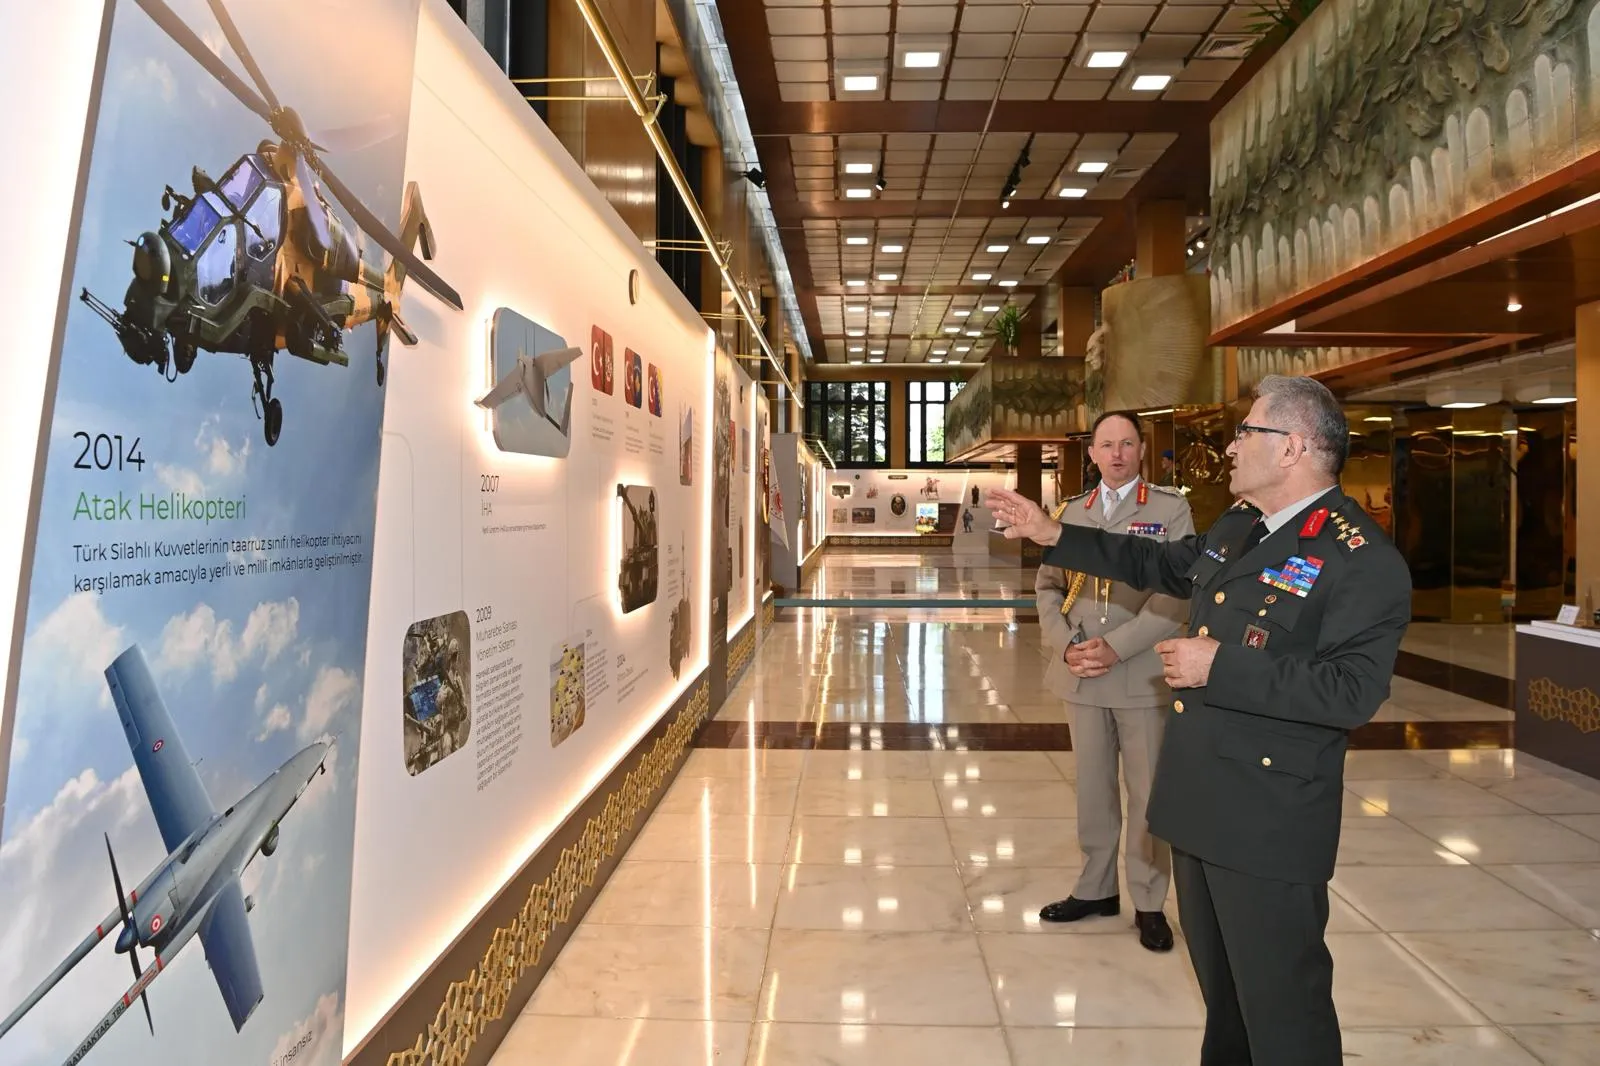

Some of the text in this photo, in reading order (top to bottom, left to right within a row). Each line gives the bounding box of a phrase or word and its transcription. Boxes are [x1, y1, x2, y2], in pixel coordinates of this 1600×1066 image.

[73, 431, 145, 472] 2014
[481, 474, 500, 492] 2007
[73, 491, 246, 525] Atak Helikopteri
[73, 543, 107, 563] Türk
[110, 541, 151, 560] Silahlı
[154, 537, 229, 557] Kuvvetlerinin
[231, 539, 266, 553] taarruz
[267, 535, 289, 550] sınıfı
[290, 535, 330, 550] helikopter
[74, 570, 151, 594] karşılamak
[154, 564, 207, 584] amacıyla
[209, 562, 231, 582] yerli
[234, 563, 245, 576] ve
[269, 556, 313, 571] imkânlarla
